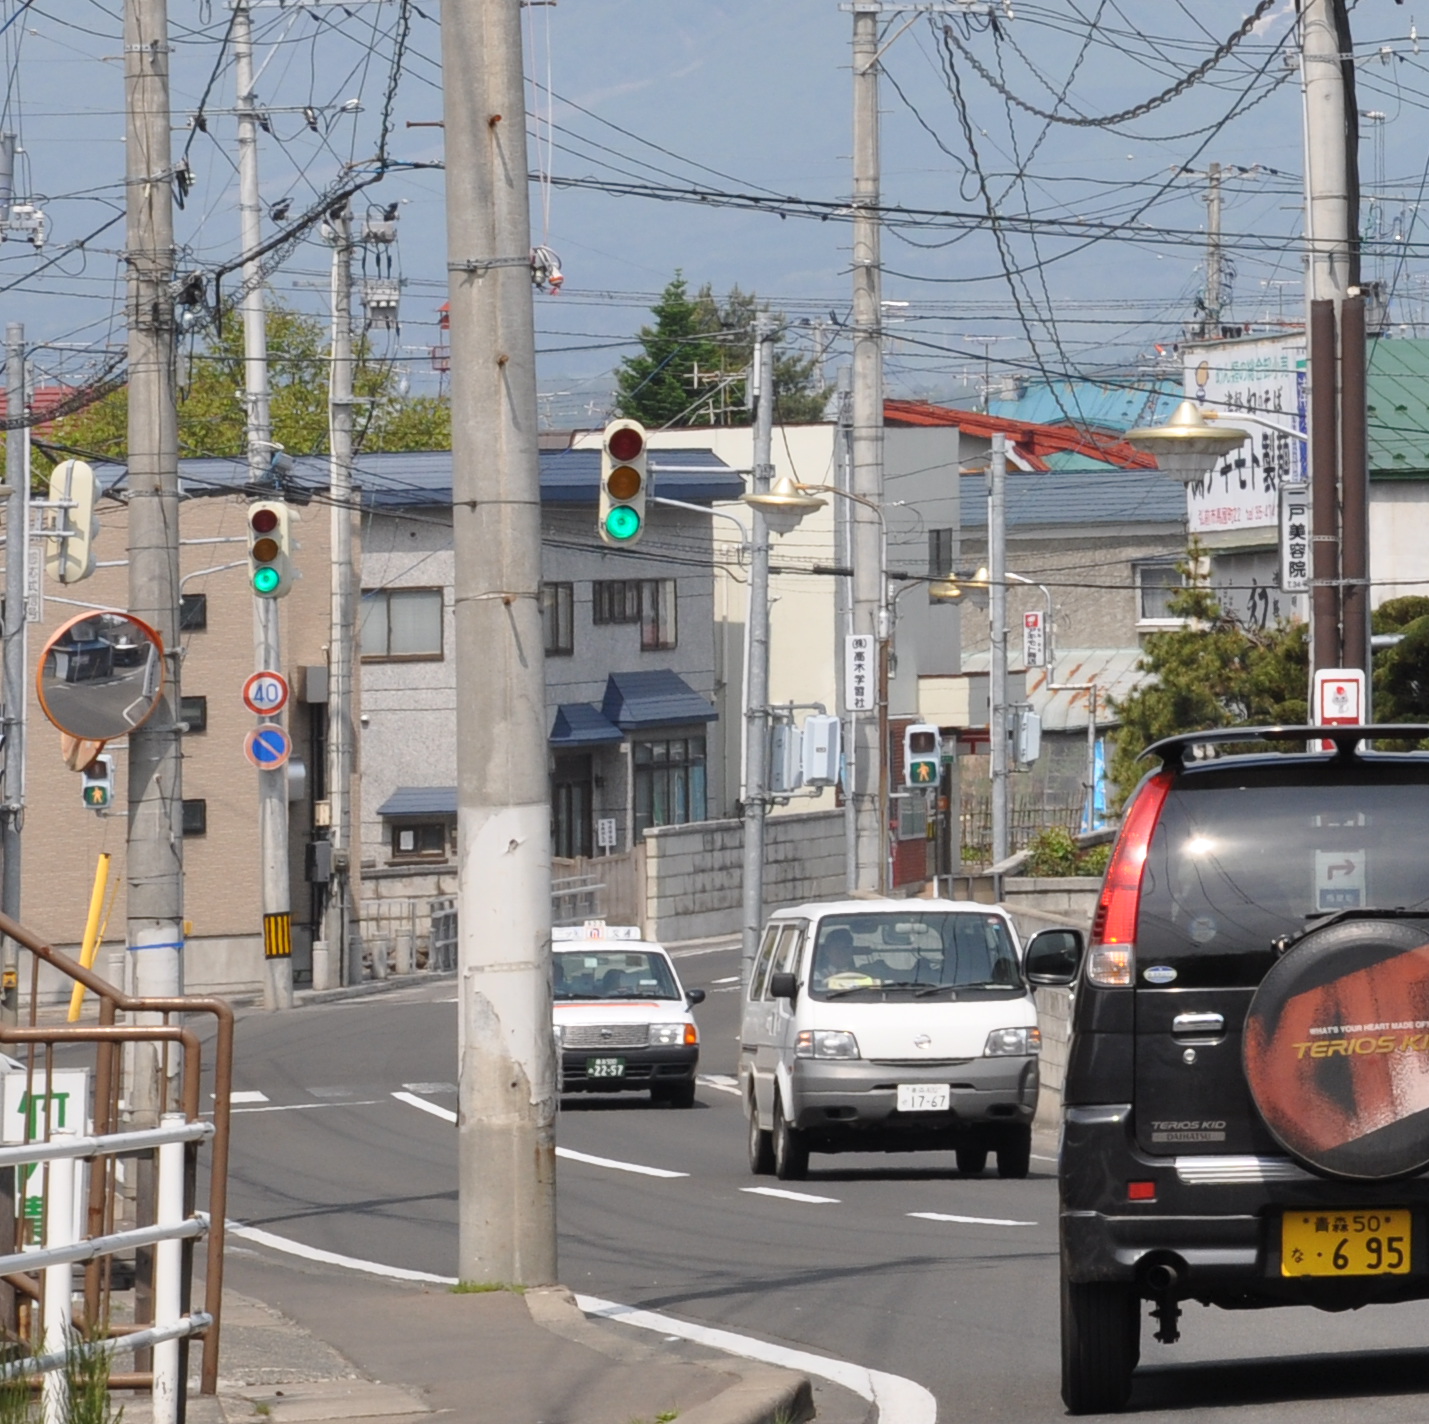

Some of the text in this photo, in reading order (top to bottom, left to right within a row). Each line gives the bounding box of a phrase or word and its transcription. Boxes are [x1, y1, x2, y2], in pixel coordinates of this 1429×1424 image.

[1287, 491, 1306, 578] 一戸美容院
[253, 683, 279, 703] 40
[1309, 1027, 1340, 1035] WHAT'S
[1341, 1025, 1362, 1033] YOUR
[1364, 1023, 1389, 1031] HEART
[1391, 1022, 1414, 1030] MADE
[1291, 1035, 1397, 1059] TERIOS
[594, 1064, 624, 1076] 22-57
[911, 1095, 946, 1108] 17-67
[1151, 1120, 1226, 1130] TERIOS KID
[1166, 1132, 1212, 1141] DAIHATSU
[1315, 1215, 1381, 1233] 青森50
[1291, 1247, 1304, 1264] な
